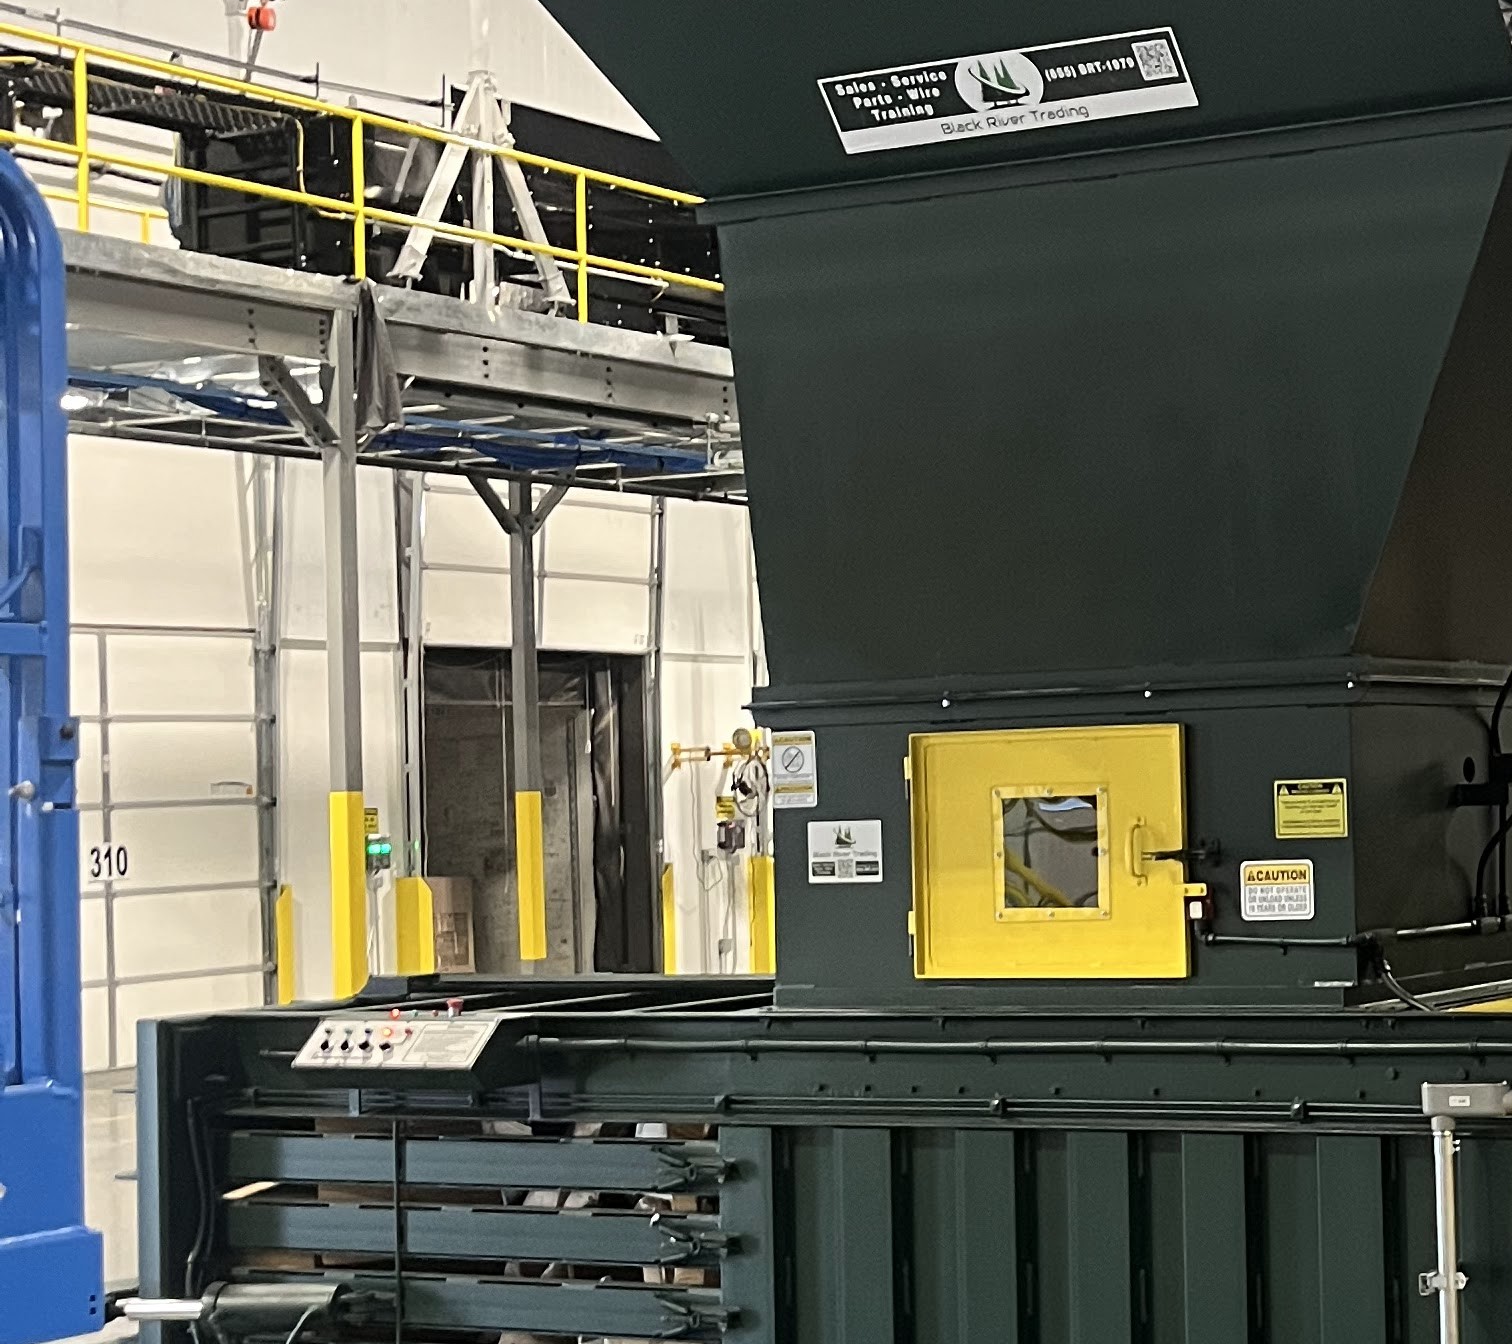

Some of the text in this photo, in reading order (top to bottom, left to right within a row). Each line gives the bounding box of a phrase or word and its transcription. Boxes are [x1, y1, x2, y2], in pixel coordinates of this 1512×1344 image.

[835, 71, 947, 96] Sales Service
[853, 87, 940, 109] Parts Wire
[871, 103, 934, 121] Training
[940, 105, 1090, 135] Black River Trading
[90, 846, 128, 877] 310
[1256, 869, 1307, 882] CAUTION
